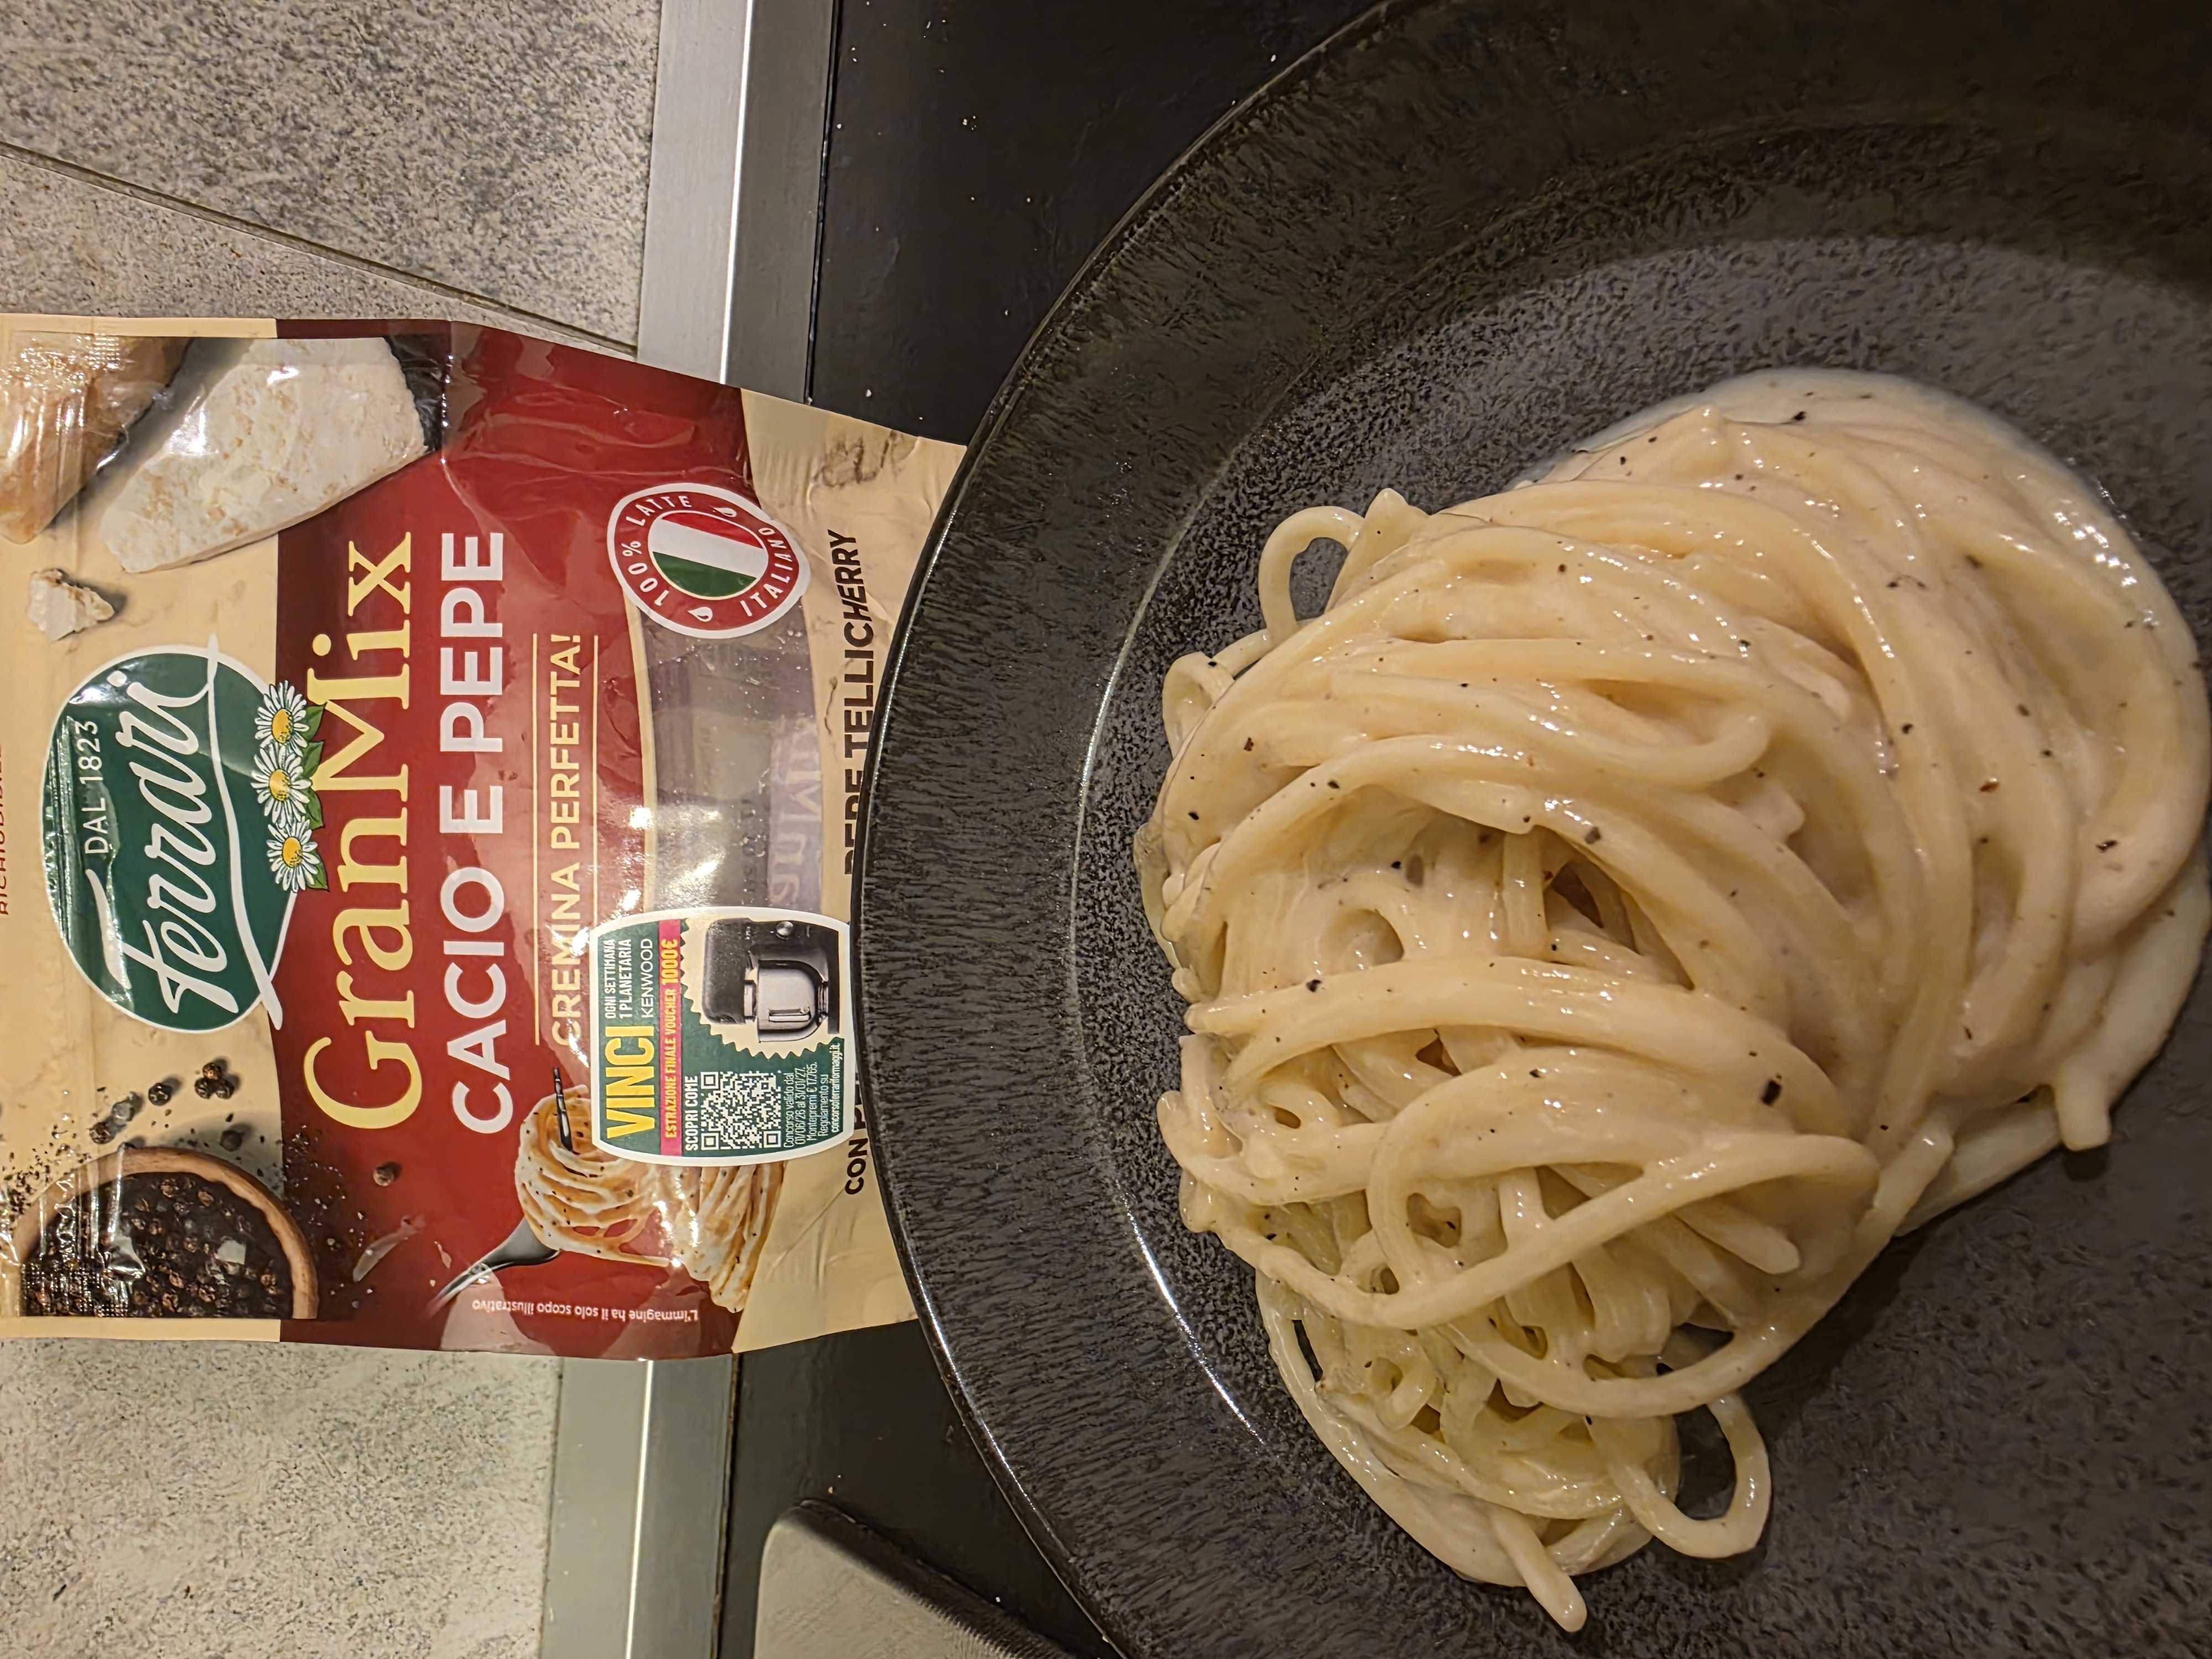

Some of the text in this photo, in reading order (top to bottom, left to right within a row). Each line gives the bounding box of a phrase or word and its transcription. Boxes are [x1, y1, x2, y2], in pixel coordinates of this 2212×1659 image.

[621, 495, 692, 606] 100% LATTE
[739, 527, 793, 617] ITALIANO
[828, 529, 874, 758] TELLICHERRY
[75, 720, 109, 854] DAL 1823
[302, 531, 423, 1130] GranMix
[85, 666, 238, 1015] Ferrari
[440, 531, 514, 1134] CACIO E PEPE
[550, 634, 581, 1046] CREMINA PERFETTA!
[604, 939, 616, 1019] OGNI SETTIMANA
[619, 939, 632, 1011] PLANETARIA
[640, 938, 654, 1018] KENWOOD
[604, 1025, 655, 1139] VINCI
[662, 939, 678, 1138] ESTRAZIONE FINALE VOUCHER 1000€
[685, 1076, 698, 1151] SCOPRI COME
[784, 1073, 794, 1147] Concorso valido dal
[807, 1095, 818, 1140] Montepremi
[818, 1074, 831, 1136] Regolamento su
[844, 1138, 868, 1195] CON
[472, 1299, 699, 1322] L'immagine ha il solo scopo illustrativo
